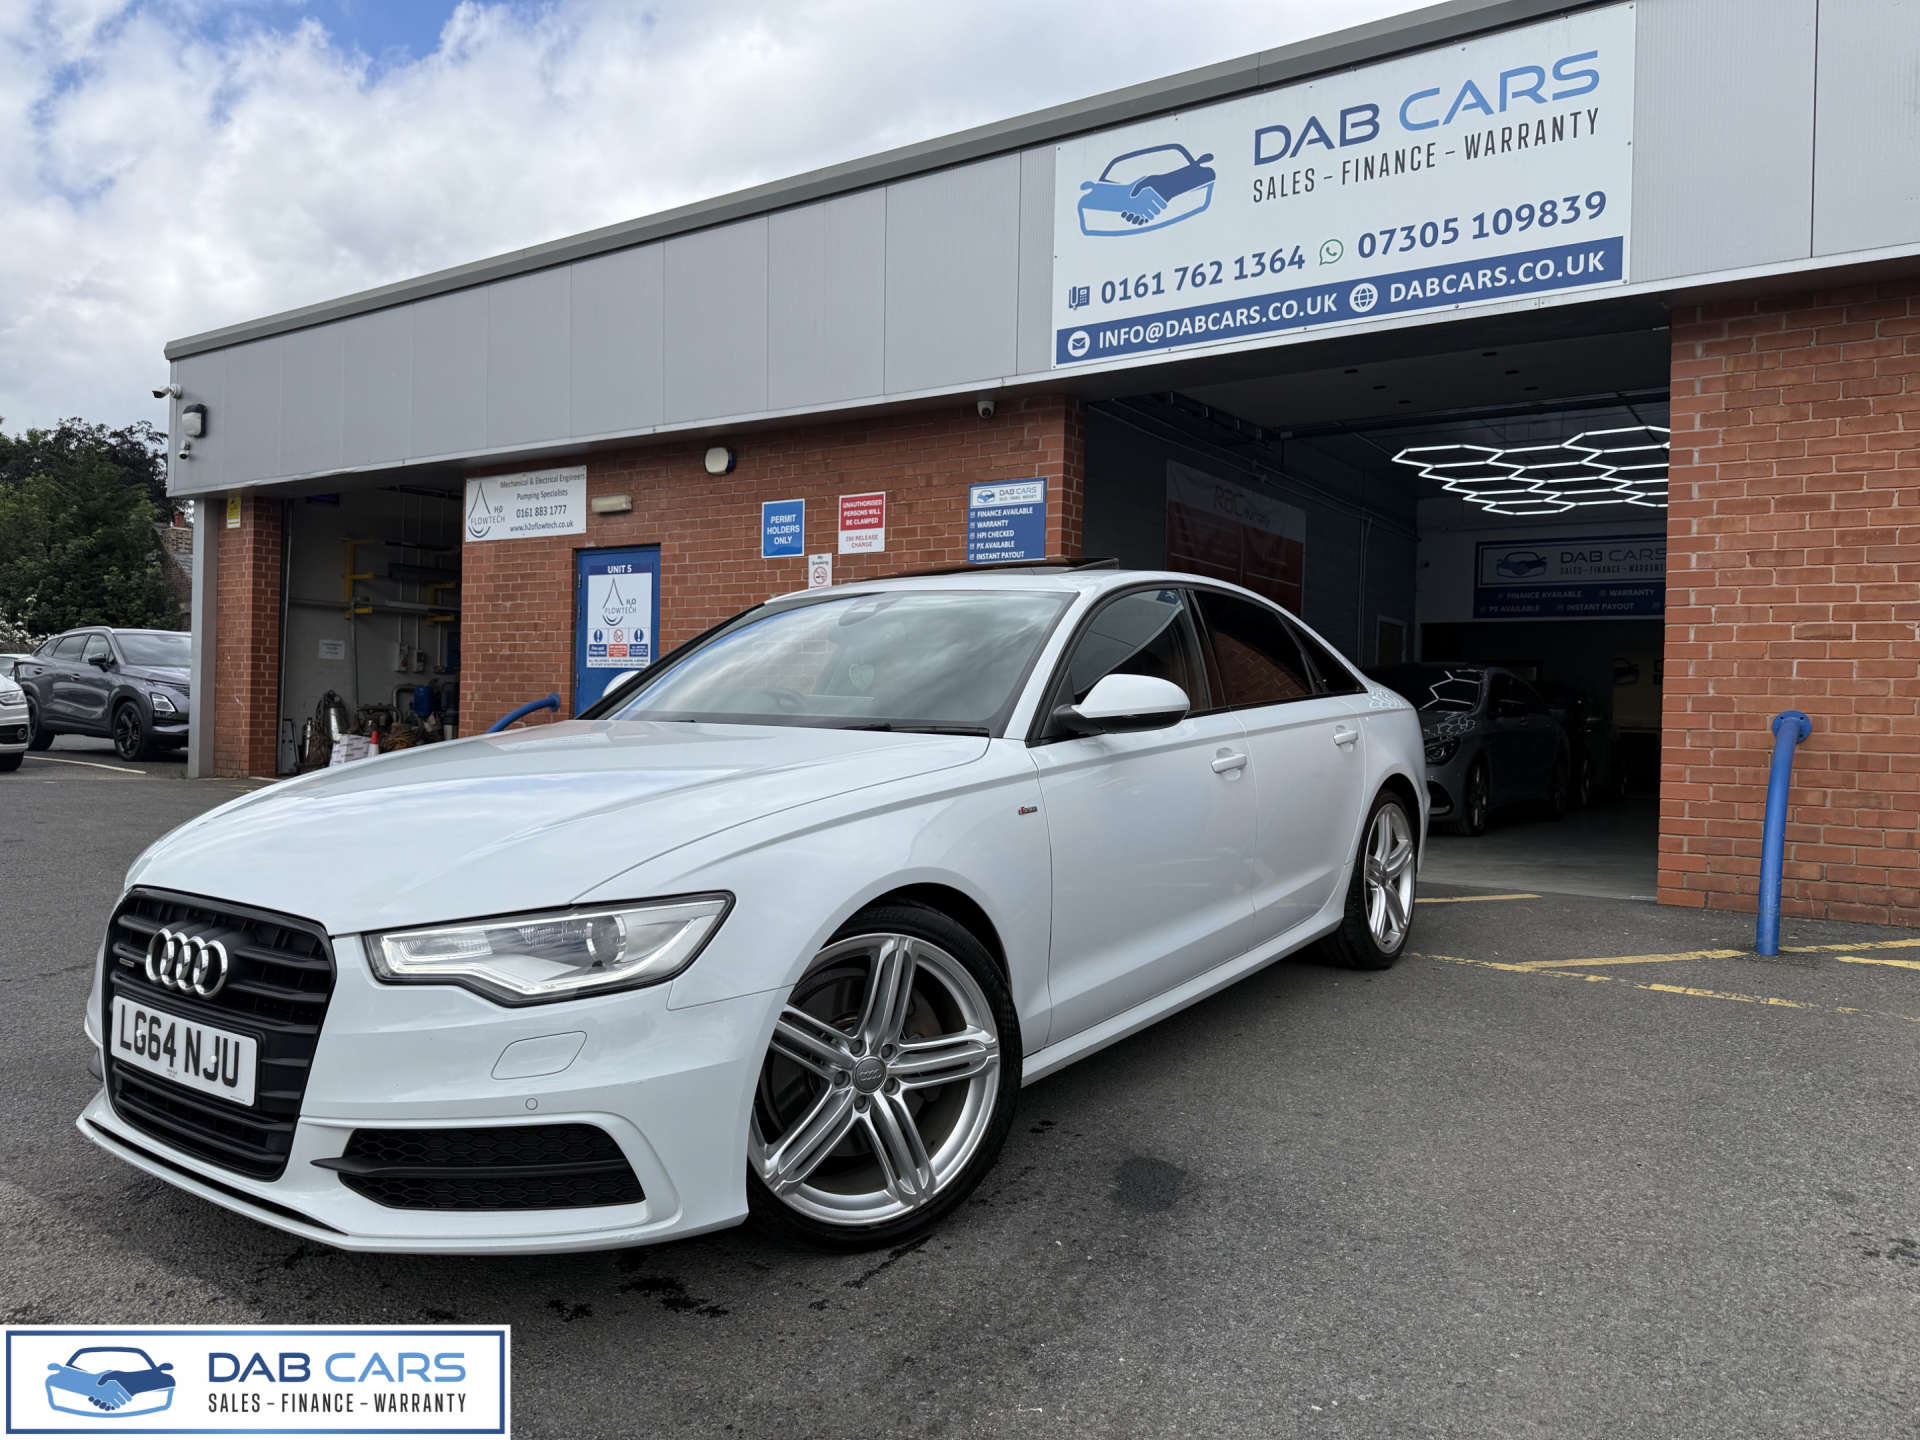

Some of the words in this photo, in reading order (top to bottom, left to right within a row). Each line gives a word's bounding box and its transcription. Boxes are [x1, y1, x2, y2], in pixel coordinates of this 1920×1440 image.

[1253, 102, 1380, 166] DAB
[1399, 50, 1600, 131] CARS
[1253, 168, 1315, 203] SALES
[1341, 145, 1436, 186] FINANCE
[1464, 107, 1600, 160] WARRANTY
[1357, 218, 1460, 259] 07305
[1471, 191, 1607, 241] 109839
[1101, 274, 1165, 305] 0161
[1174, 261, 1223, 291] 762
[1233, 245, 1306, 282] 1364
[1389, 250, 1605, 304] DABCARS.CO.UK
[1098, 292, 1337, 349] INFO@DABCARS.CO.UK
[559, 473, 585, 482] Engineers
[516, 491, 540, 501] Pumping
[541, 489, 568, 499] Specialists
[1016, 486, 1037, 495] CARS
[516, 507, 533, 518] 0161
[535, 505, 548, 517] 883
[550, 504, 567, 515] 1777
[977, 509, 1002, 518] FINANCE
[1002, 507, 1033, 516] AVAILABLE
[471, 515, 506, 526] FLOWTECH
[771, 514, 796, 524] PERMIT
[977, 519, 1009, 528] WARRANTY
[767, 525, 800, 535] HOLDERS
[988, 530, 1015, 538] CHECKED
[774, 536, 792, 545] ONLY
[985, 540, 1015, 549] AVAILABLE
[1001, 550, 1025, 559] PAYOUT
[1560, 551, 1603, 563] DAB
[608, 565, 627, 574] UNIT
[627, 565, 632, 573] 5
[604, 607, 637, 615] FLOWTECH
[119, 1004, 177, 1068] LG64
[184, 1026, 240, 1088] NJU
